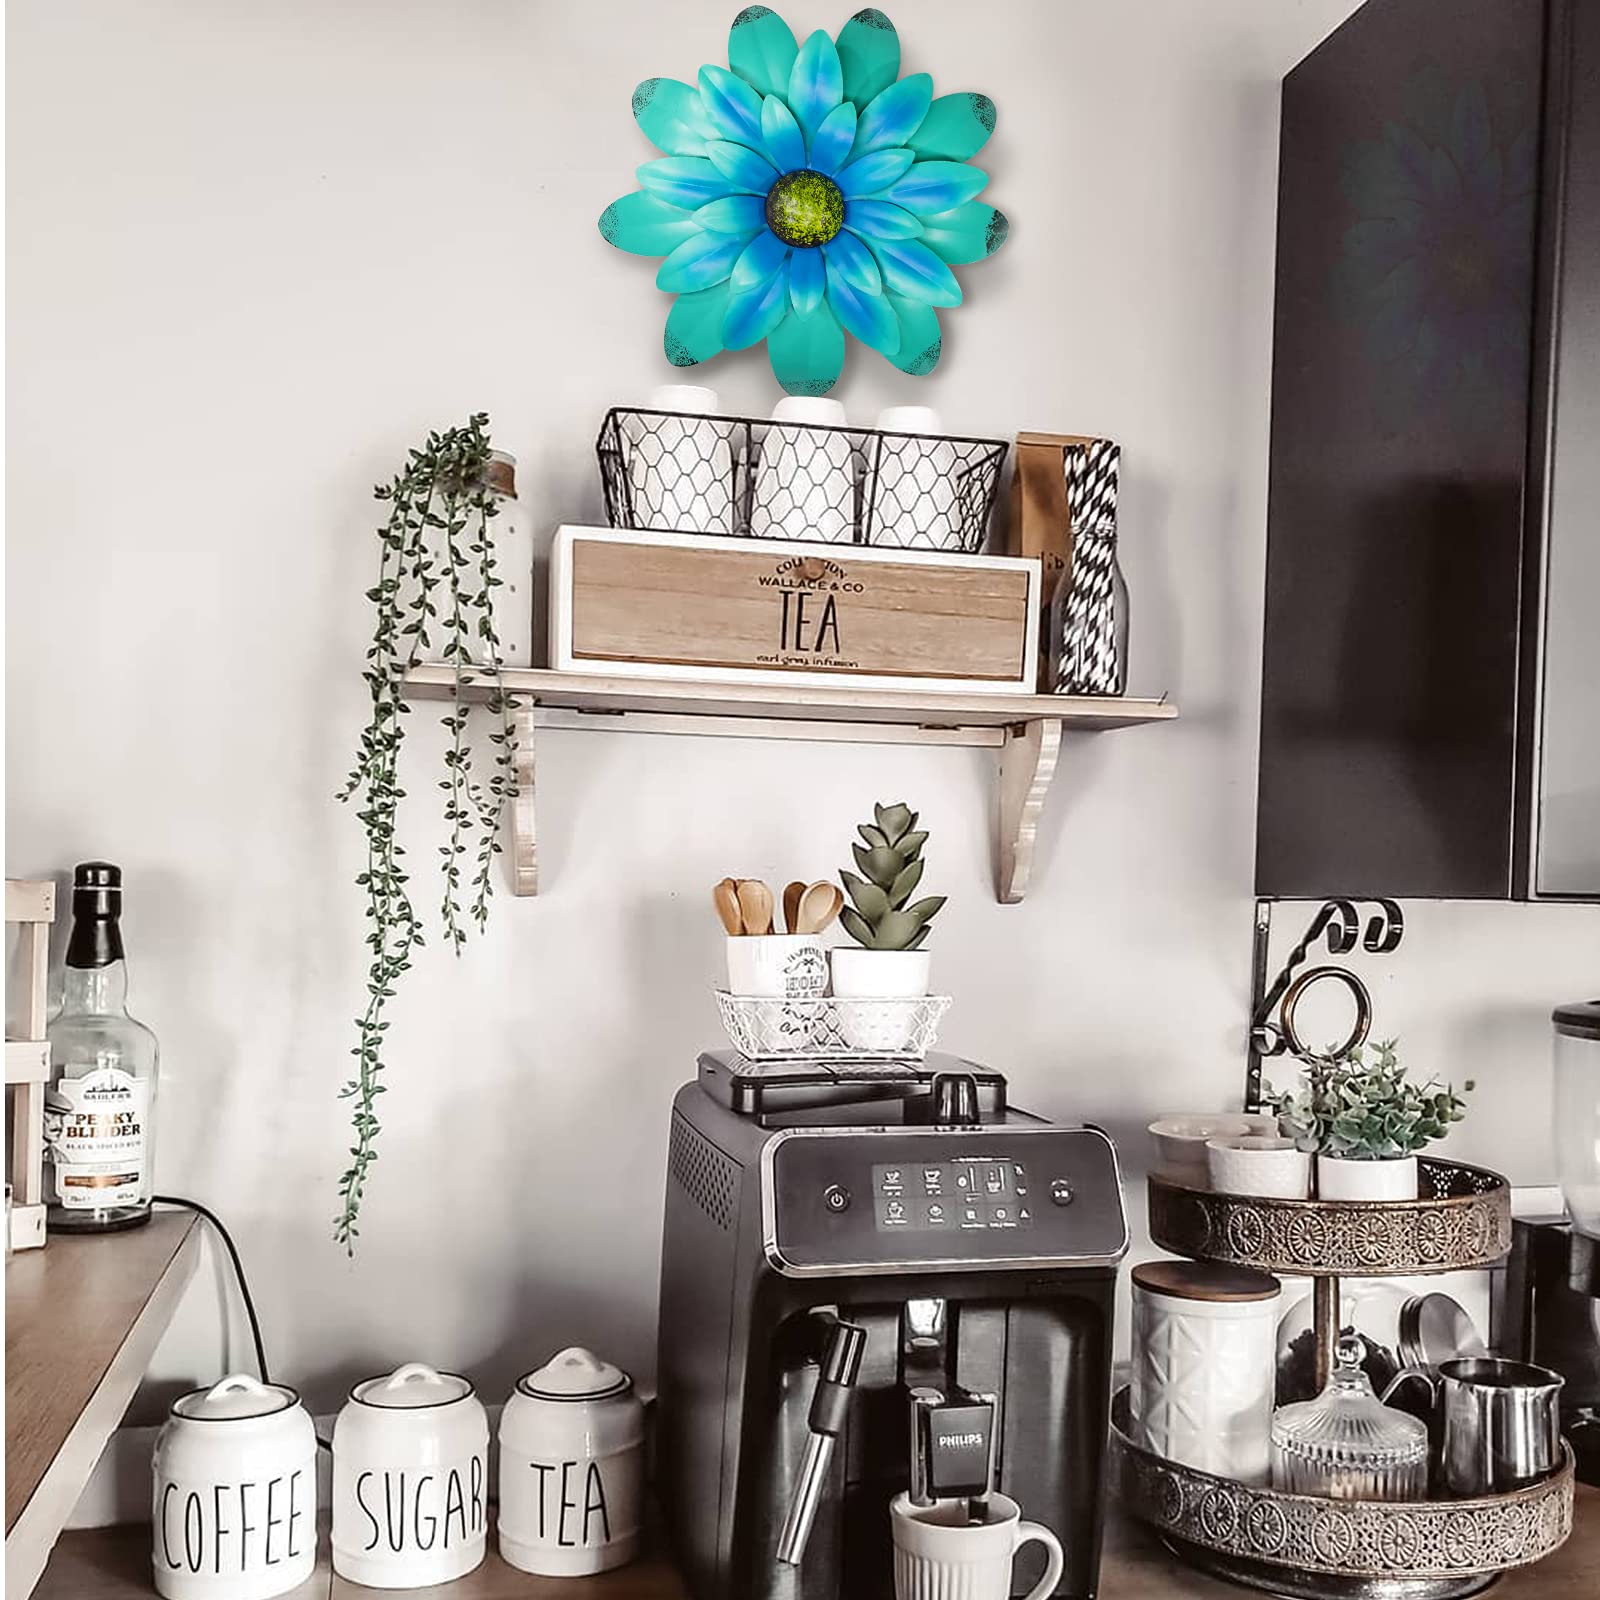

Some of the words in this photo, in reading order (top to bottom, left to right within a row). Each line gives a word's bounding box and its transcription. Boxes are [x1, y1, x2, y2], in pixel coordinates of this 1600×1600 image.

[758, 576, 827, 591] WALLACE
[829, 582, 840, 591] &
[842, 582, 864, 593] CO
[778, 590, 840, 654] TEA
[939, 1433, 983, 1447] PHILIPS
[161, 1469, 303, 1574] COFFEE
[355, 1454, 484, 1552] SUGAR
[529, 1459, 611, 1547] TEA
